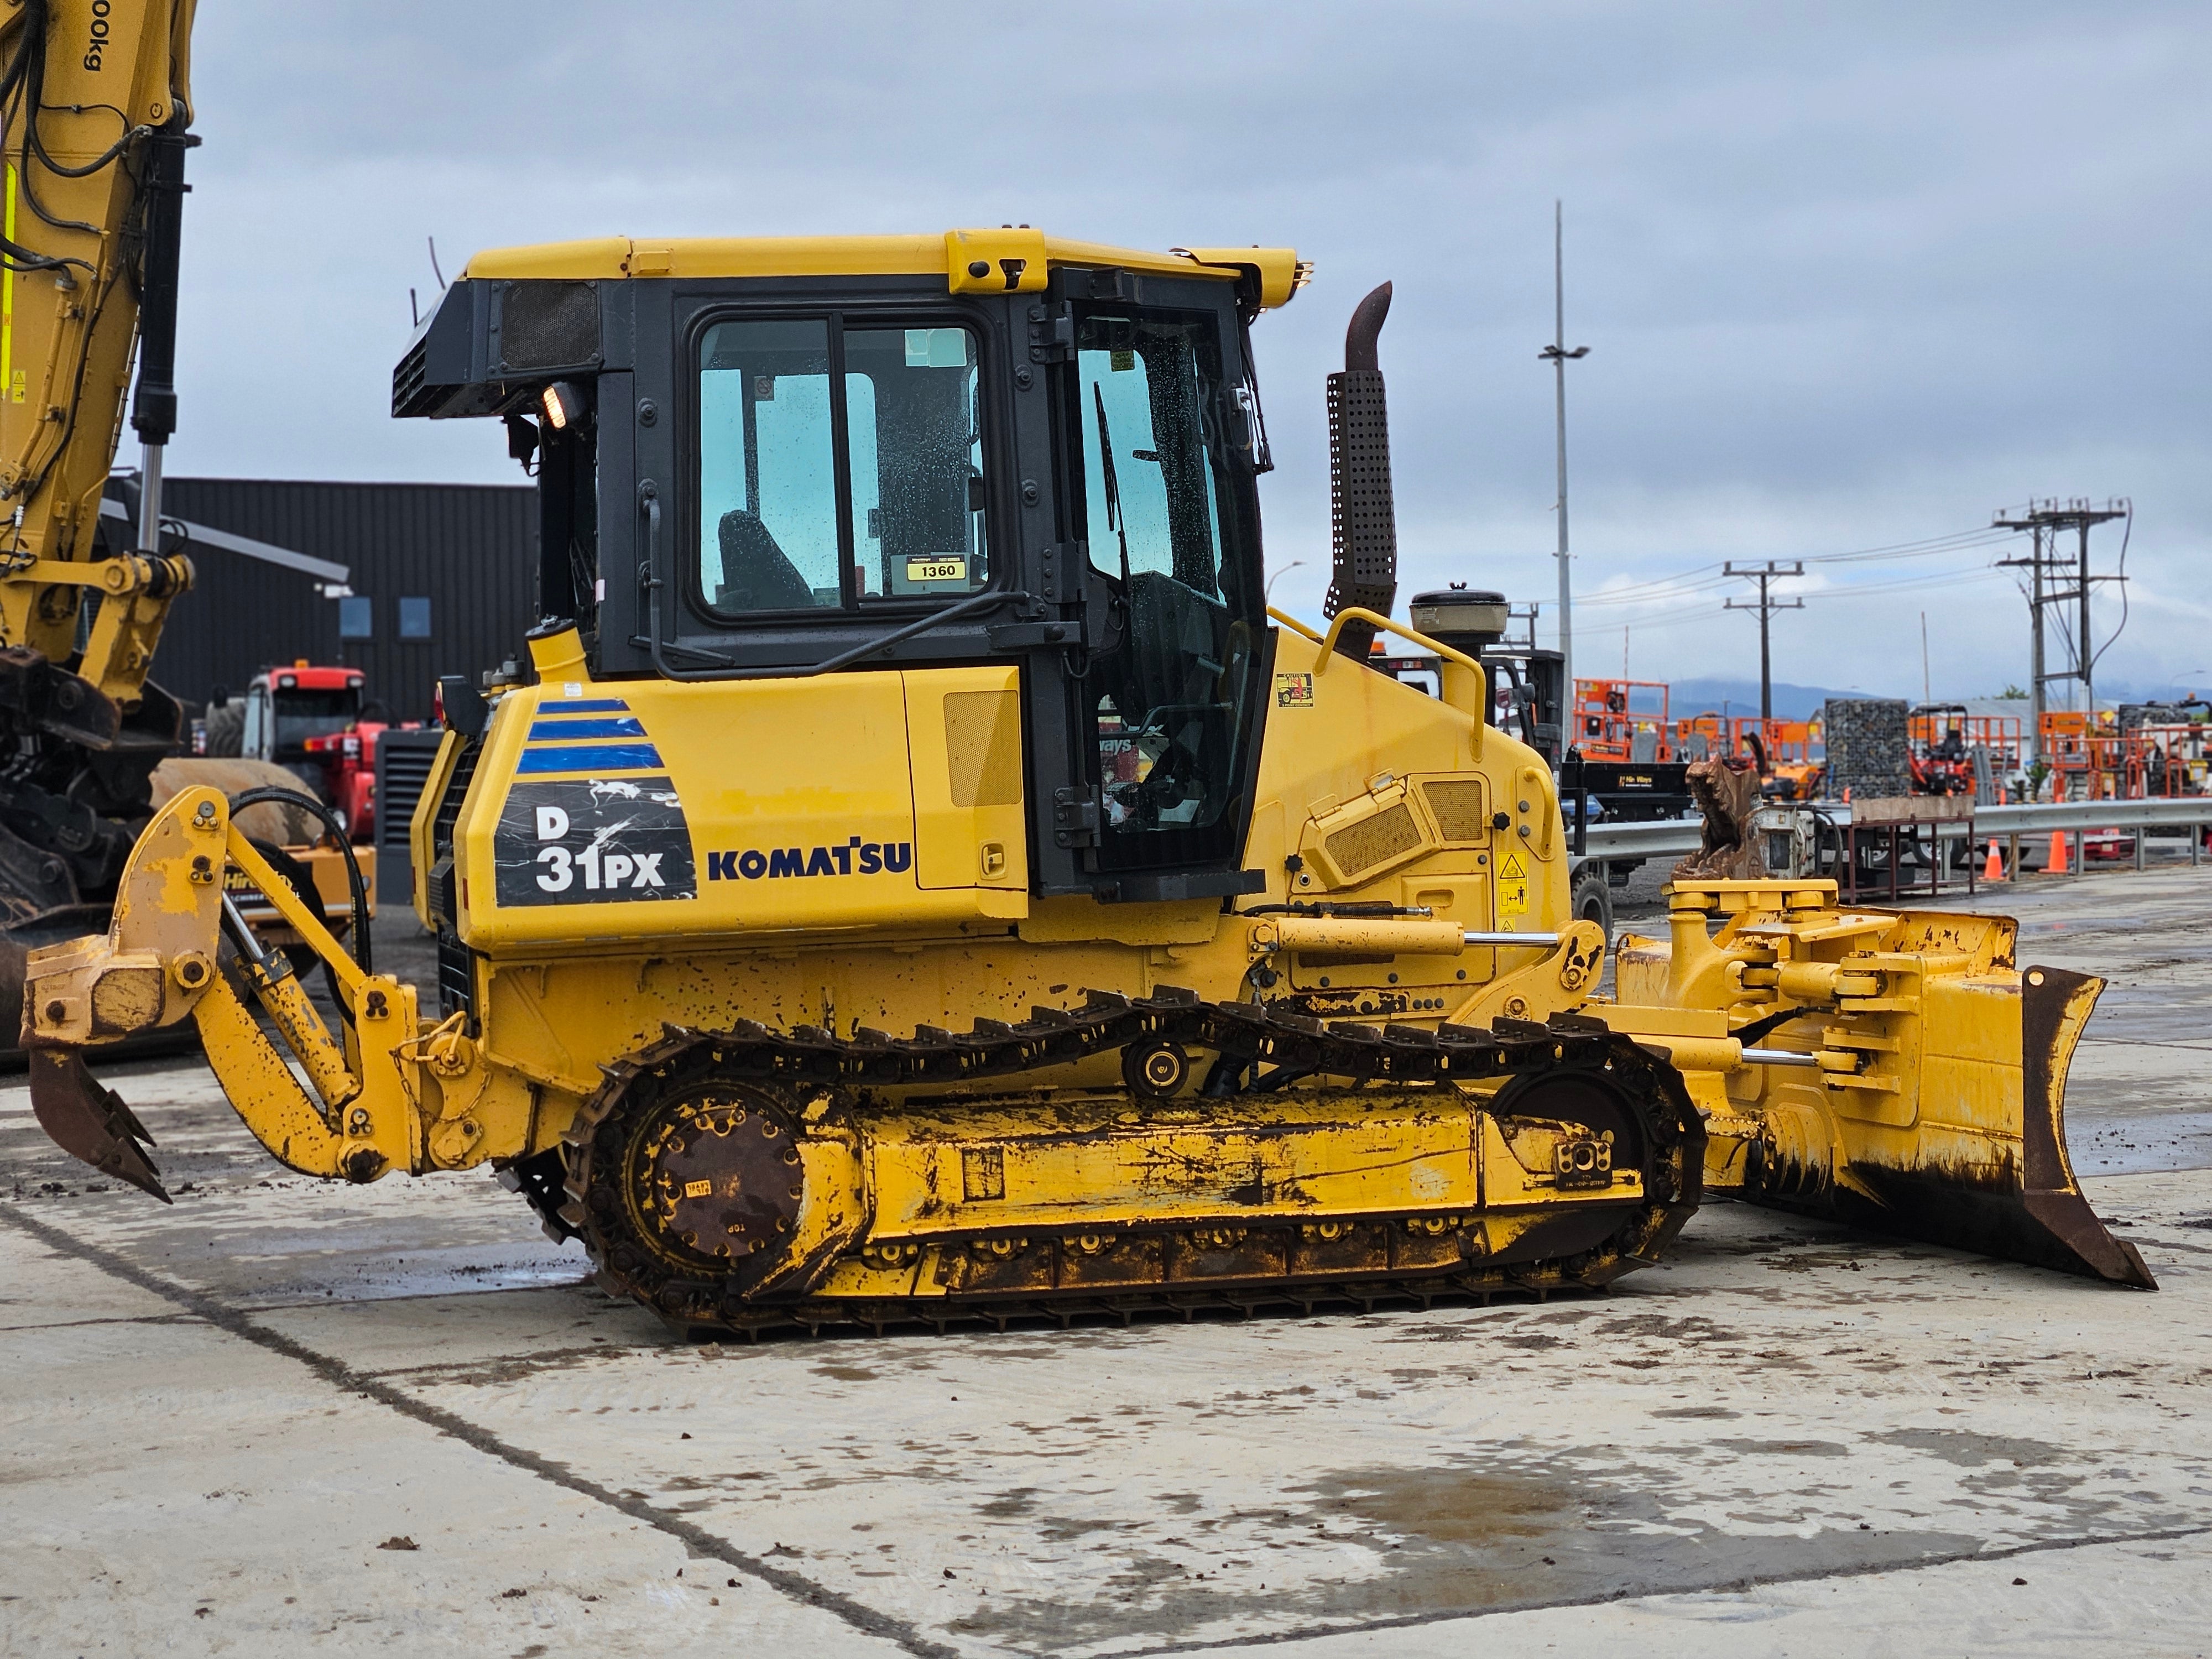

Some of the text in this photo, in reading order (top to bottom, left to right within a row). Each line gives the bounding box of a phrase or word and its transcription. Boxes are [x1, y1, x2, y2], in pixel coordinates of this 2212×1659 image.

[922, 565, 956, 577] 1360
[536, 807, 569, 840] D
[536, 845, 666, 892] 31PX
[708, 836, 911, 881] KOMATSU
[728, 1223, 745, 1233] TOP
